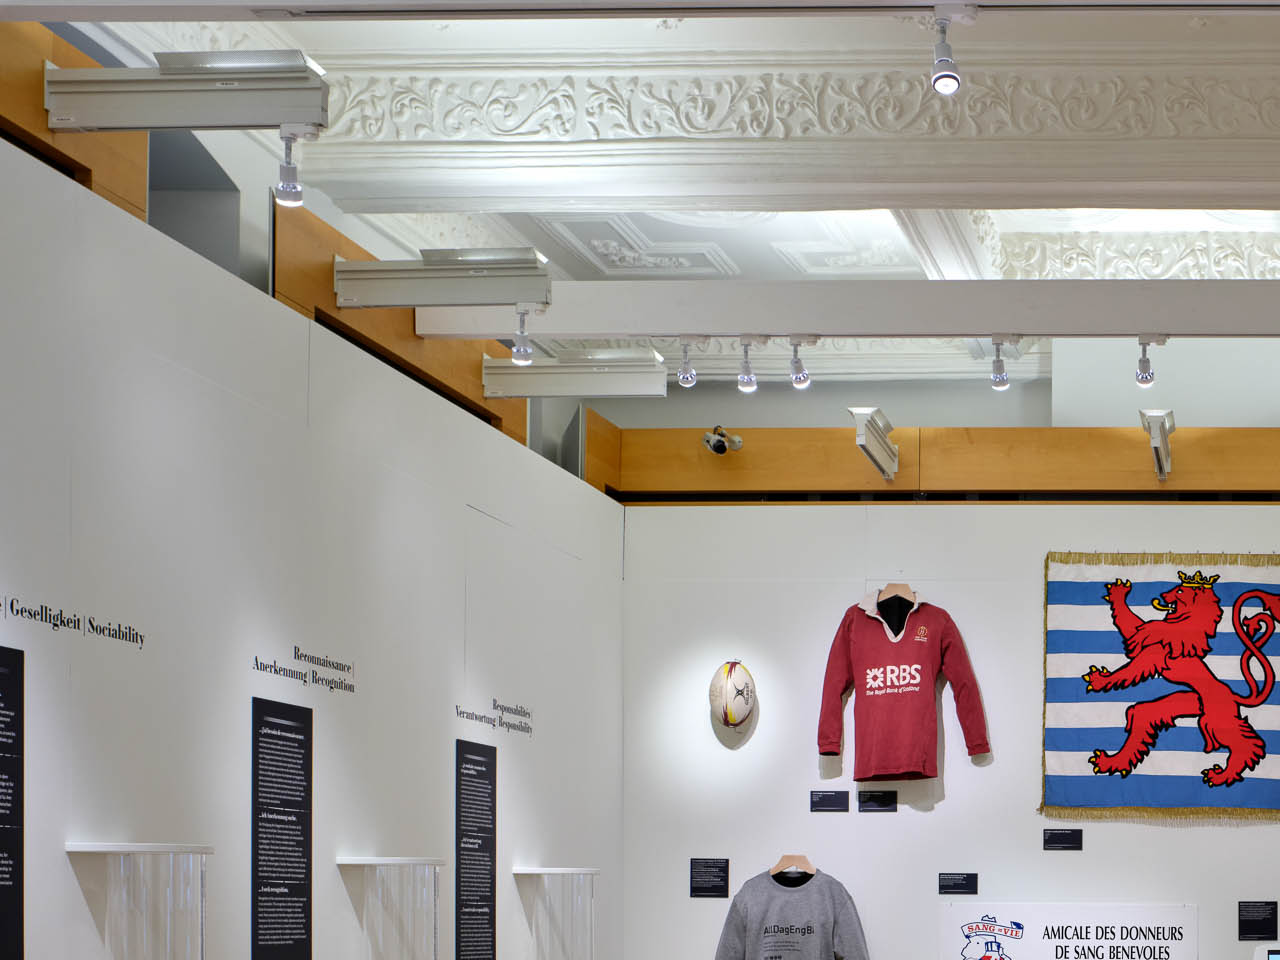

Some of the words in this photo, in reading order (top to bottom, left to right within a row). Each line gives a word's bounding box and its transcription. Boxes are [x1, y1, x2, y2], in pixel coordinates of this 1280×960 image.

[10, 598, 80, 631] Geselligkeit
[88, 616, 145, 650] Sociability
[294, 645, 351, 673] Reconnaissance
[252, 656, 307, 686] Anerkennung
[312, 670, 355, 693] Recognition
[886, 664, 922, 686] RBS
[968, 924, 995, 932] SANG
[1043, 926, 1091, 940] AMICALE
[1096, 926, 1116, 940] DES
[1120, 926, 1183, 940] DONNEURS
[1055, 945, 1070, 959] DE
[1074, 945, 1104, 960] SANG
[1109, 946, 1170, 960] BENEVOLES
